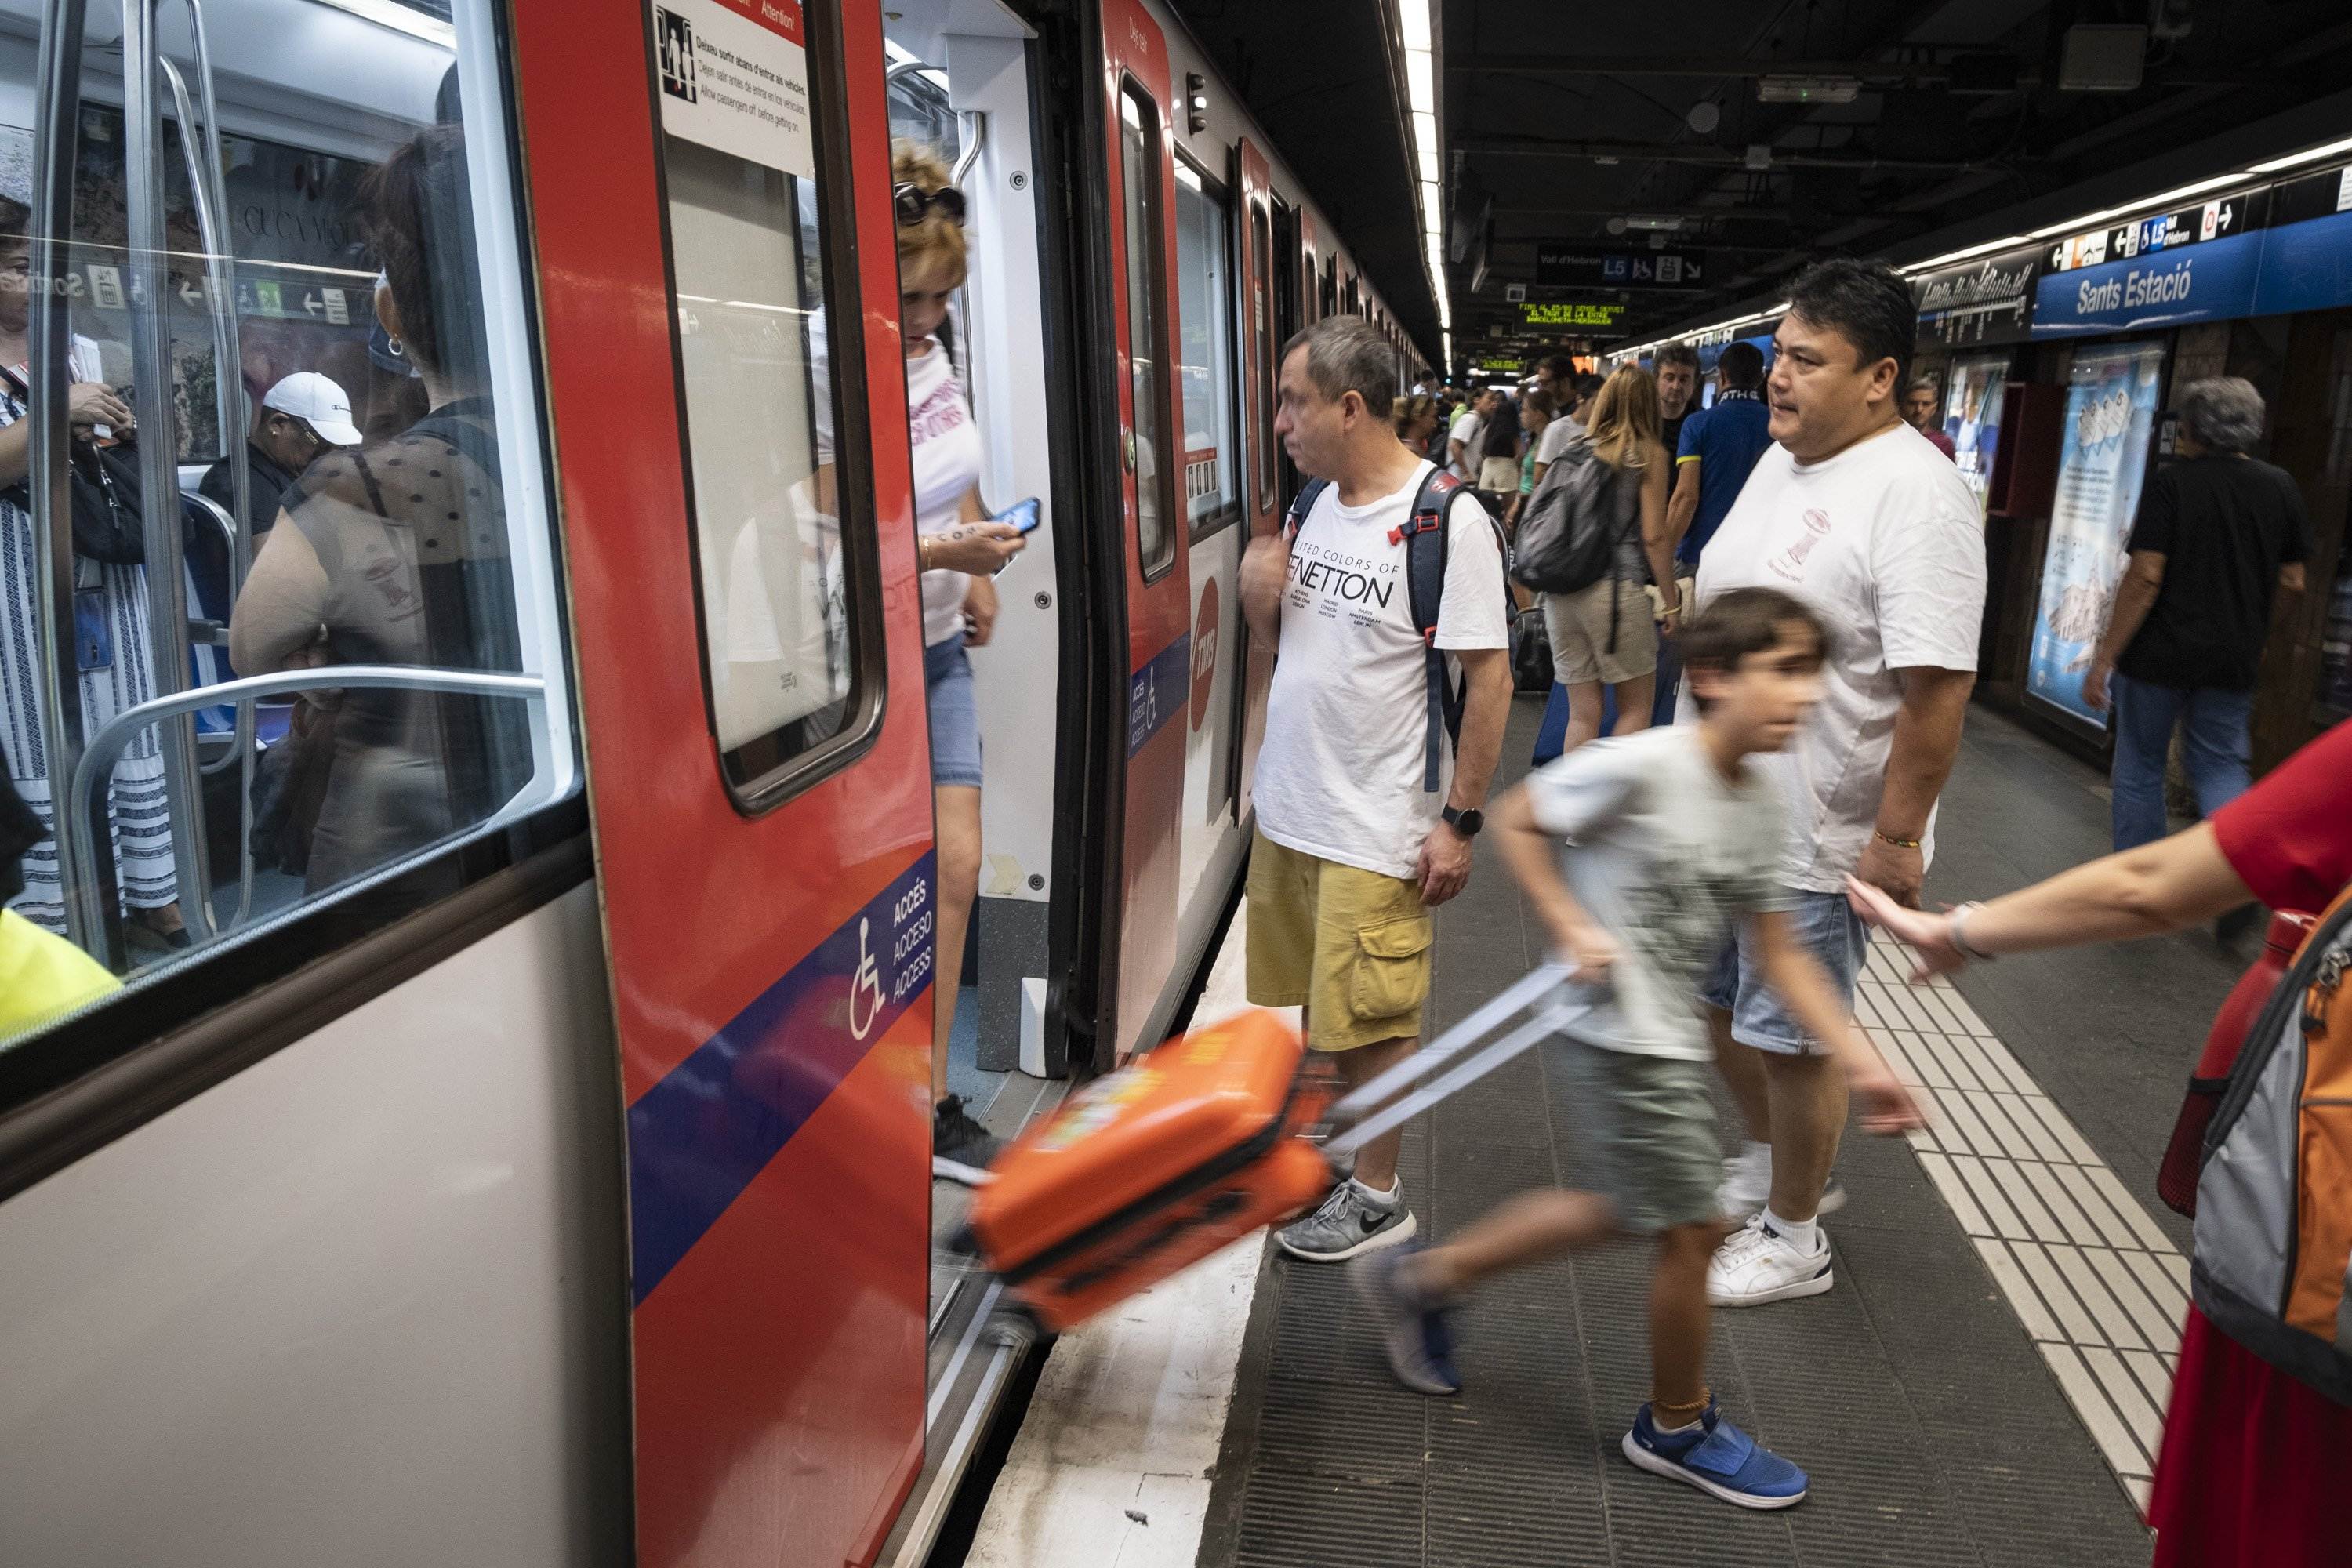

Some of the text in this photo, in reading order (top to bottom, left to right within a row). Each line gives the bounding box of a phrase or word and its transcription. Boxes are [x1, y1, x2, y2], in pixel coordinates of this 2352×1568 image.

[760, 0, 794, 31] Attention!
[696, 36, 717, 56] Deixeu
[719, 49, 734, 63] sortir
[735, 56, 753, 72] abans
[753, 64, 775, 82] d'entrar
[698, 60, 715, 78] Dejen
[716, 69, 728, 82] salir
[729, 75, 743, 89] antes
[744, 80, 752, 93] de
[753, 85, 767, 99] entrar
[768, 92, 775, 102] en
[701, 84, 716, 100] Allow
[717, 93, 748, 113] passengers
[757, 108, 775, 123] before
[775, 115, 791, 132] getting
[2151, 222, 2165, 245] L5
[1541, 255, 1602, 265] Vall d'Hebron
[1604, 260, 1625, 274] L5
[2078, 278, 2122, 314] Sants
[2124, 258, 2193, 307] Estació
[1295, 541, 1399, 575] ITED COLORS OF
[1287, 554, 1394, 608] ENETTON
[1294, 589, 1309, 597] ATHENS
[1290, 593, 1311, 604] BARCELONA
[1320, 604, 1337, 613] LONDON
[1323, 598, 1338, 607] MADRID
[1318, 610, 1336, 619] MOSCOW
[1348, 612, 1381, 625] AMSTERDAM
[1196, 627, 1215, 680] TMB
[1132, 702, 1145, 724] ACCESO
[1131, 724, 1145, 748] ACCESS
[894, 877, 926, 927] ACCÉS
[893, 910, 932, 966] ACCESO
[893, 946, 931, 1004] ACCESS
